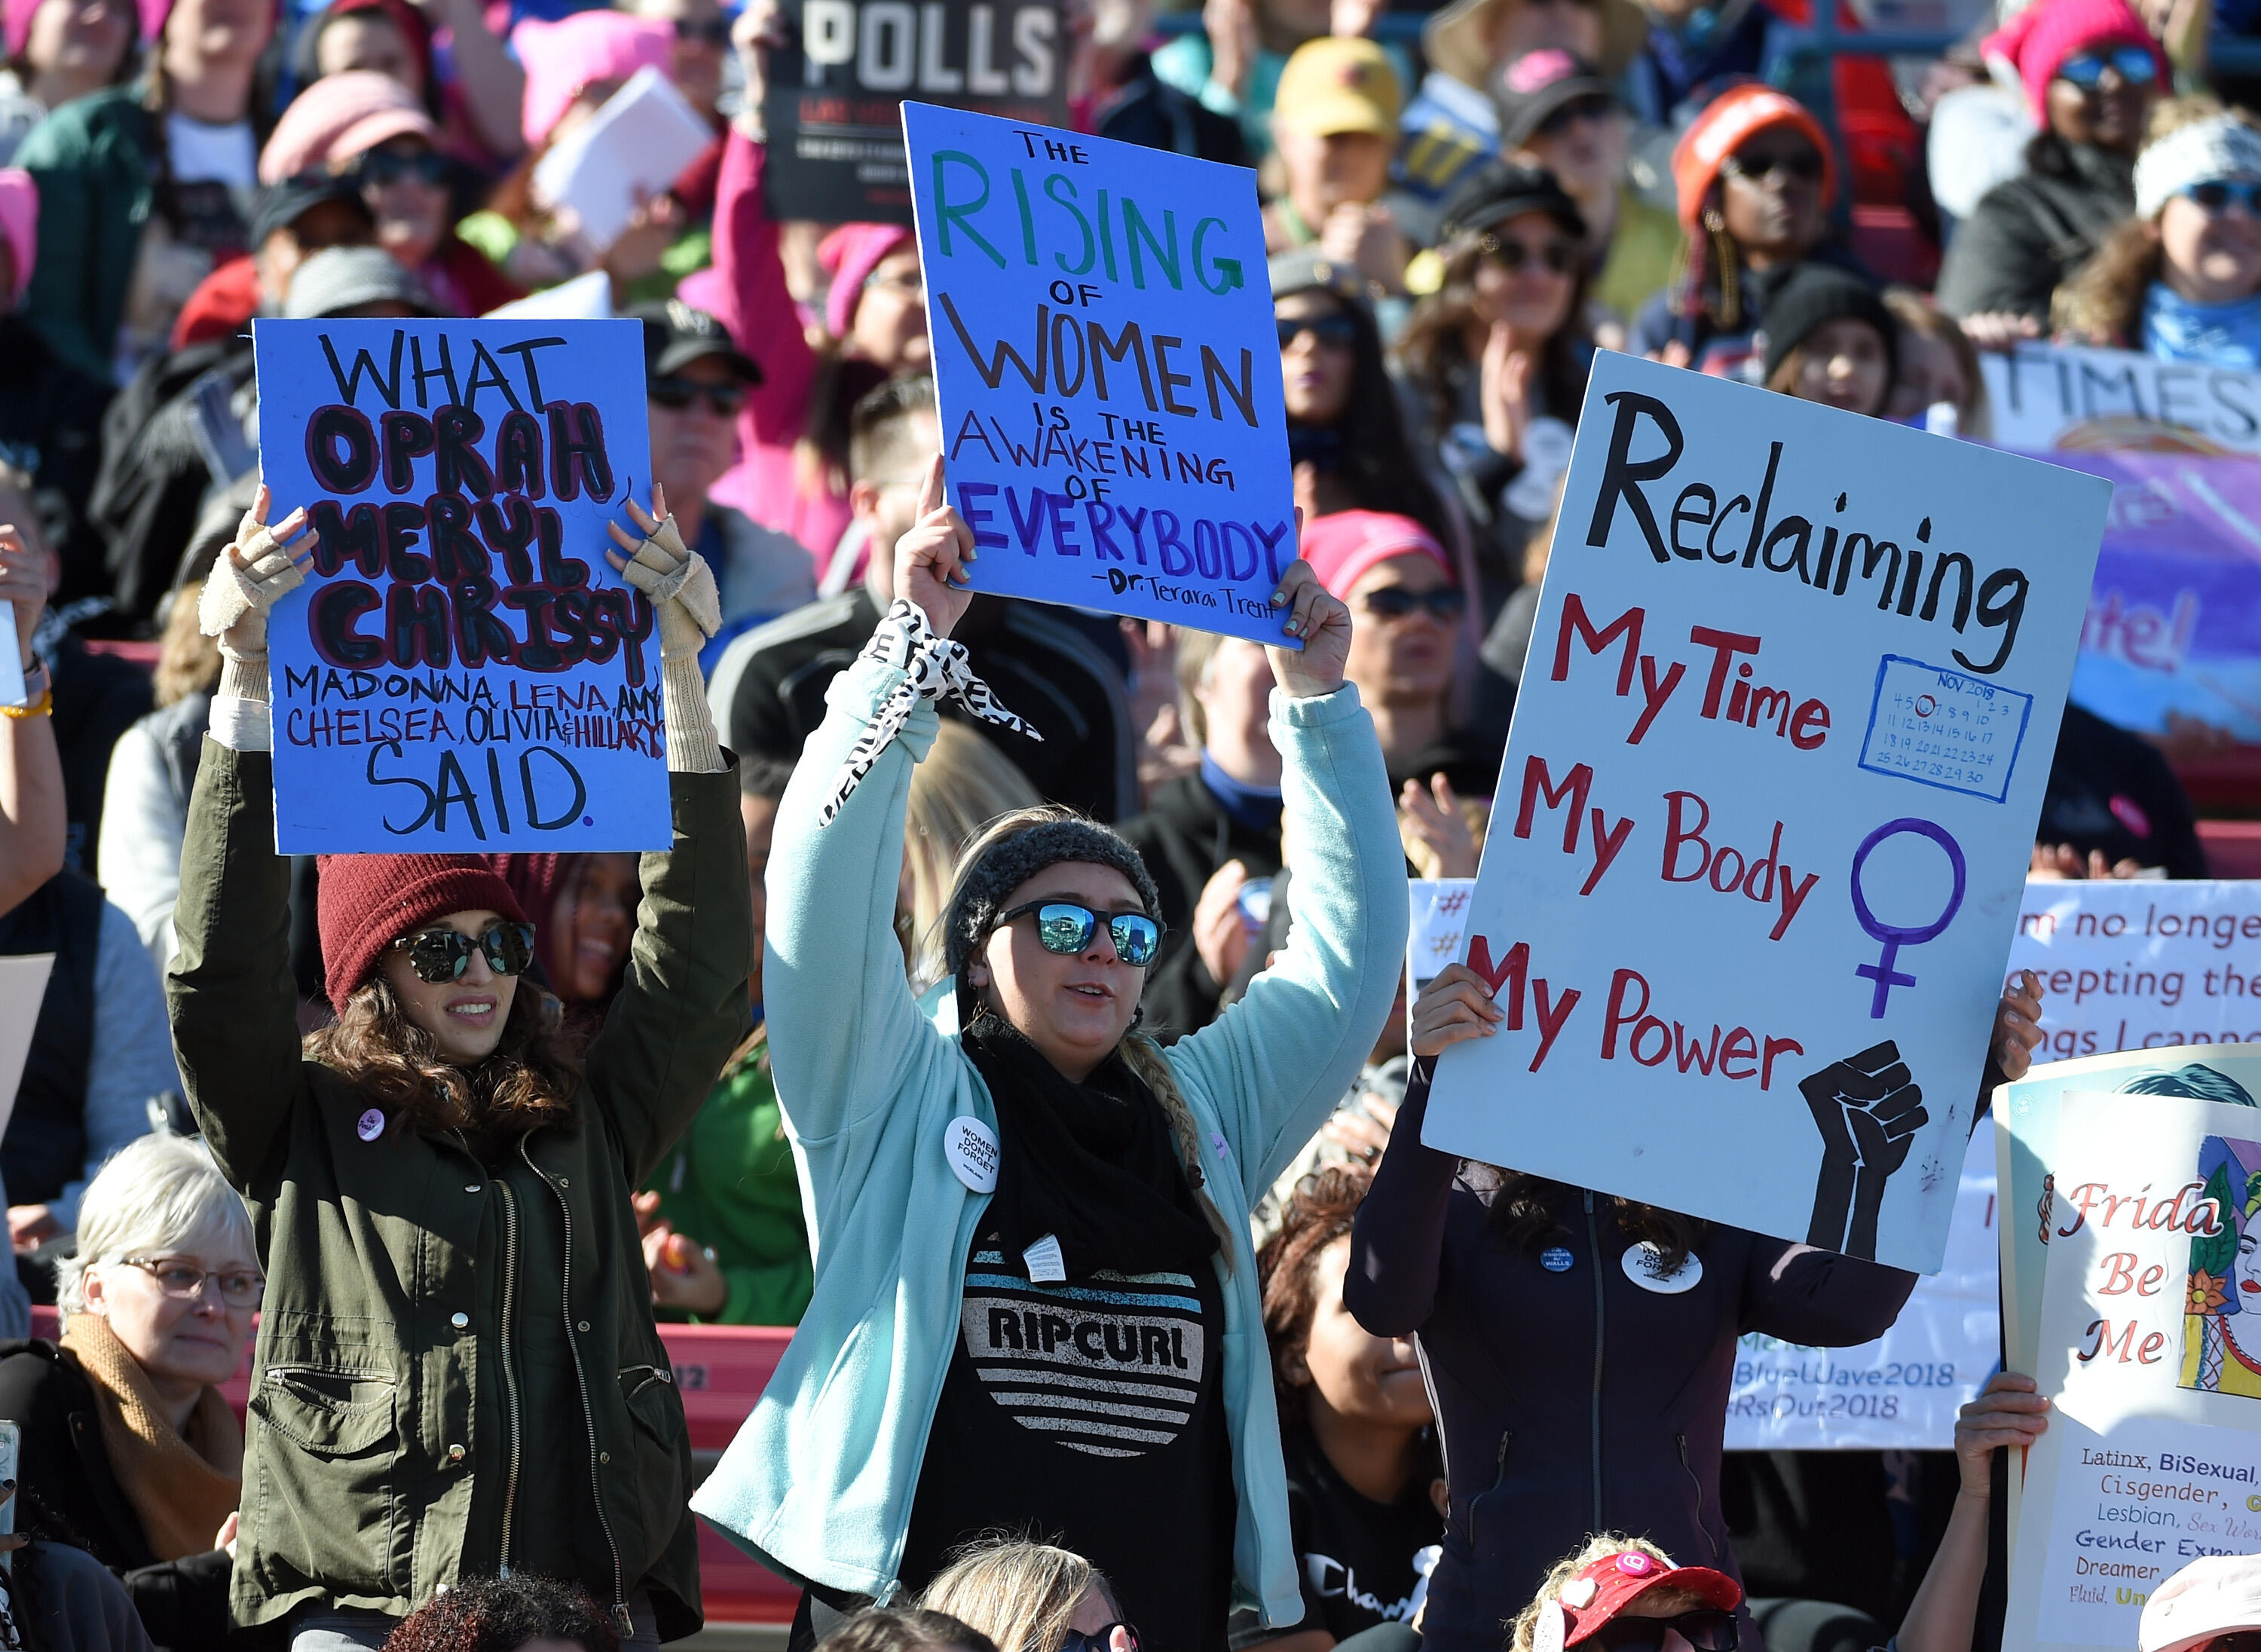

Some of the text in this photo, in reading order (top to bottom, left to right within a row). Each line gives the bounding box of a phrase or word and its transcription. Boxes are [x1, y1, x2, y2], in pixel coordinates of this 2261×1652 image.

[803, 0, 1057, 98] POLLS
[1012, 130, 1090, 164] THE
[932, 149, 1245, 296] RISING
[1049, 280, 1103, 307] OF
[318, 329, 567, 414] WHAT
[938, 292, 1259, 428] WOMEN
[1976, 351, 2261, 442] TIMES
[1033, 402, 1167, 446] IS THE
[950, 410, 1235, 491] AWAKENING
[1065, 475, 1112, 503] OF
[957, 482, 1288, 585] EVERYBODY
[1586, 391, 2029, 674] Reclaiming
[1219, 588, 1278, 620] Trent
[2081, 589, 2195, 674] te!
[1551, 592, 1831, 751] My Time
[1938, 673, 1996, 701] NOV 2018
[1895, 693, 1903, 708] 4
[1905, 696, 1914, 710] 5
[1935, 704, 1942, 716] 7
[1948, 707, 1957, 718] 8
[1962, 711, 1969, 722] 9
[1976, 714, 1990, 725] 10
[1988, 702, 1996, 712] 2
[2002, 705, 2009, 716] 3
[1888, 714, 1993, 745] 11 12 13 14 15 16 17
[1877, 752, 1984, 783] 25 26 27 28 29 30
[1884, 733, 1993, 766] 18 19 20 21 22 23 24
[367, 740, 594, 841] SAID.
[1513, 754, 1820, 941] My Body
[2075, 913, 2128, 938] no
[1467, 935, 1804, 1091] My Power
[957, 1143, 996, 1174] FORGET
[962, 1125, 998, 1158] WOMEN
[964, 1137, 993, 1162] DON'T
[2058, 1182, 2223, 1237] Frida
[2097, 1252, 2164, 1296] Be
[2077, 1320, 2164, 1365] Me
[2081, 1448, 2259, 1487] Latinx, BiSexual,
[2100, 1474, 2229, 1510] Cisgender,
[2097, 1503, 2180, 1528] Lesbian,
[2187, 1513, 2219, 1533] Sex
[2076, 1529, 2166, 1554] Gender
